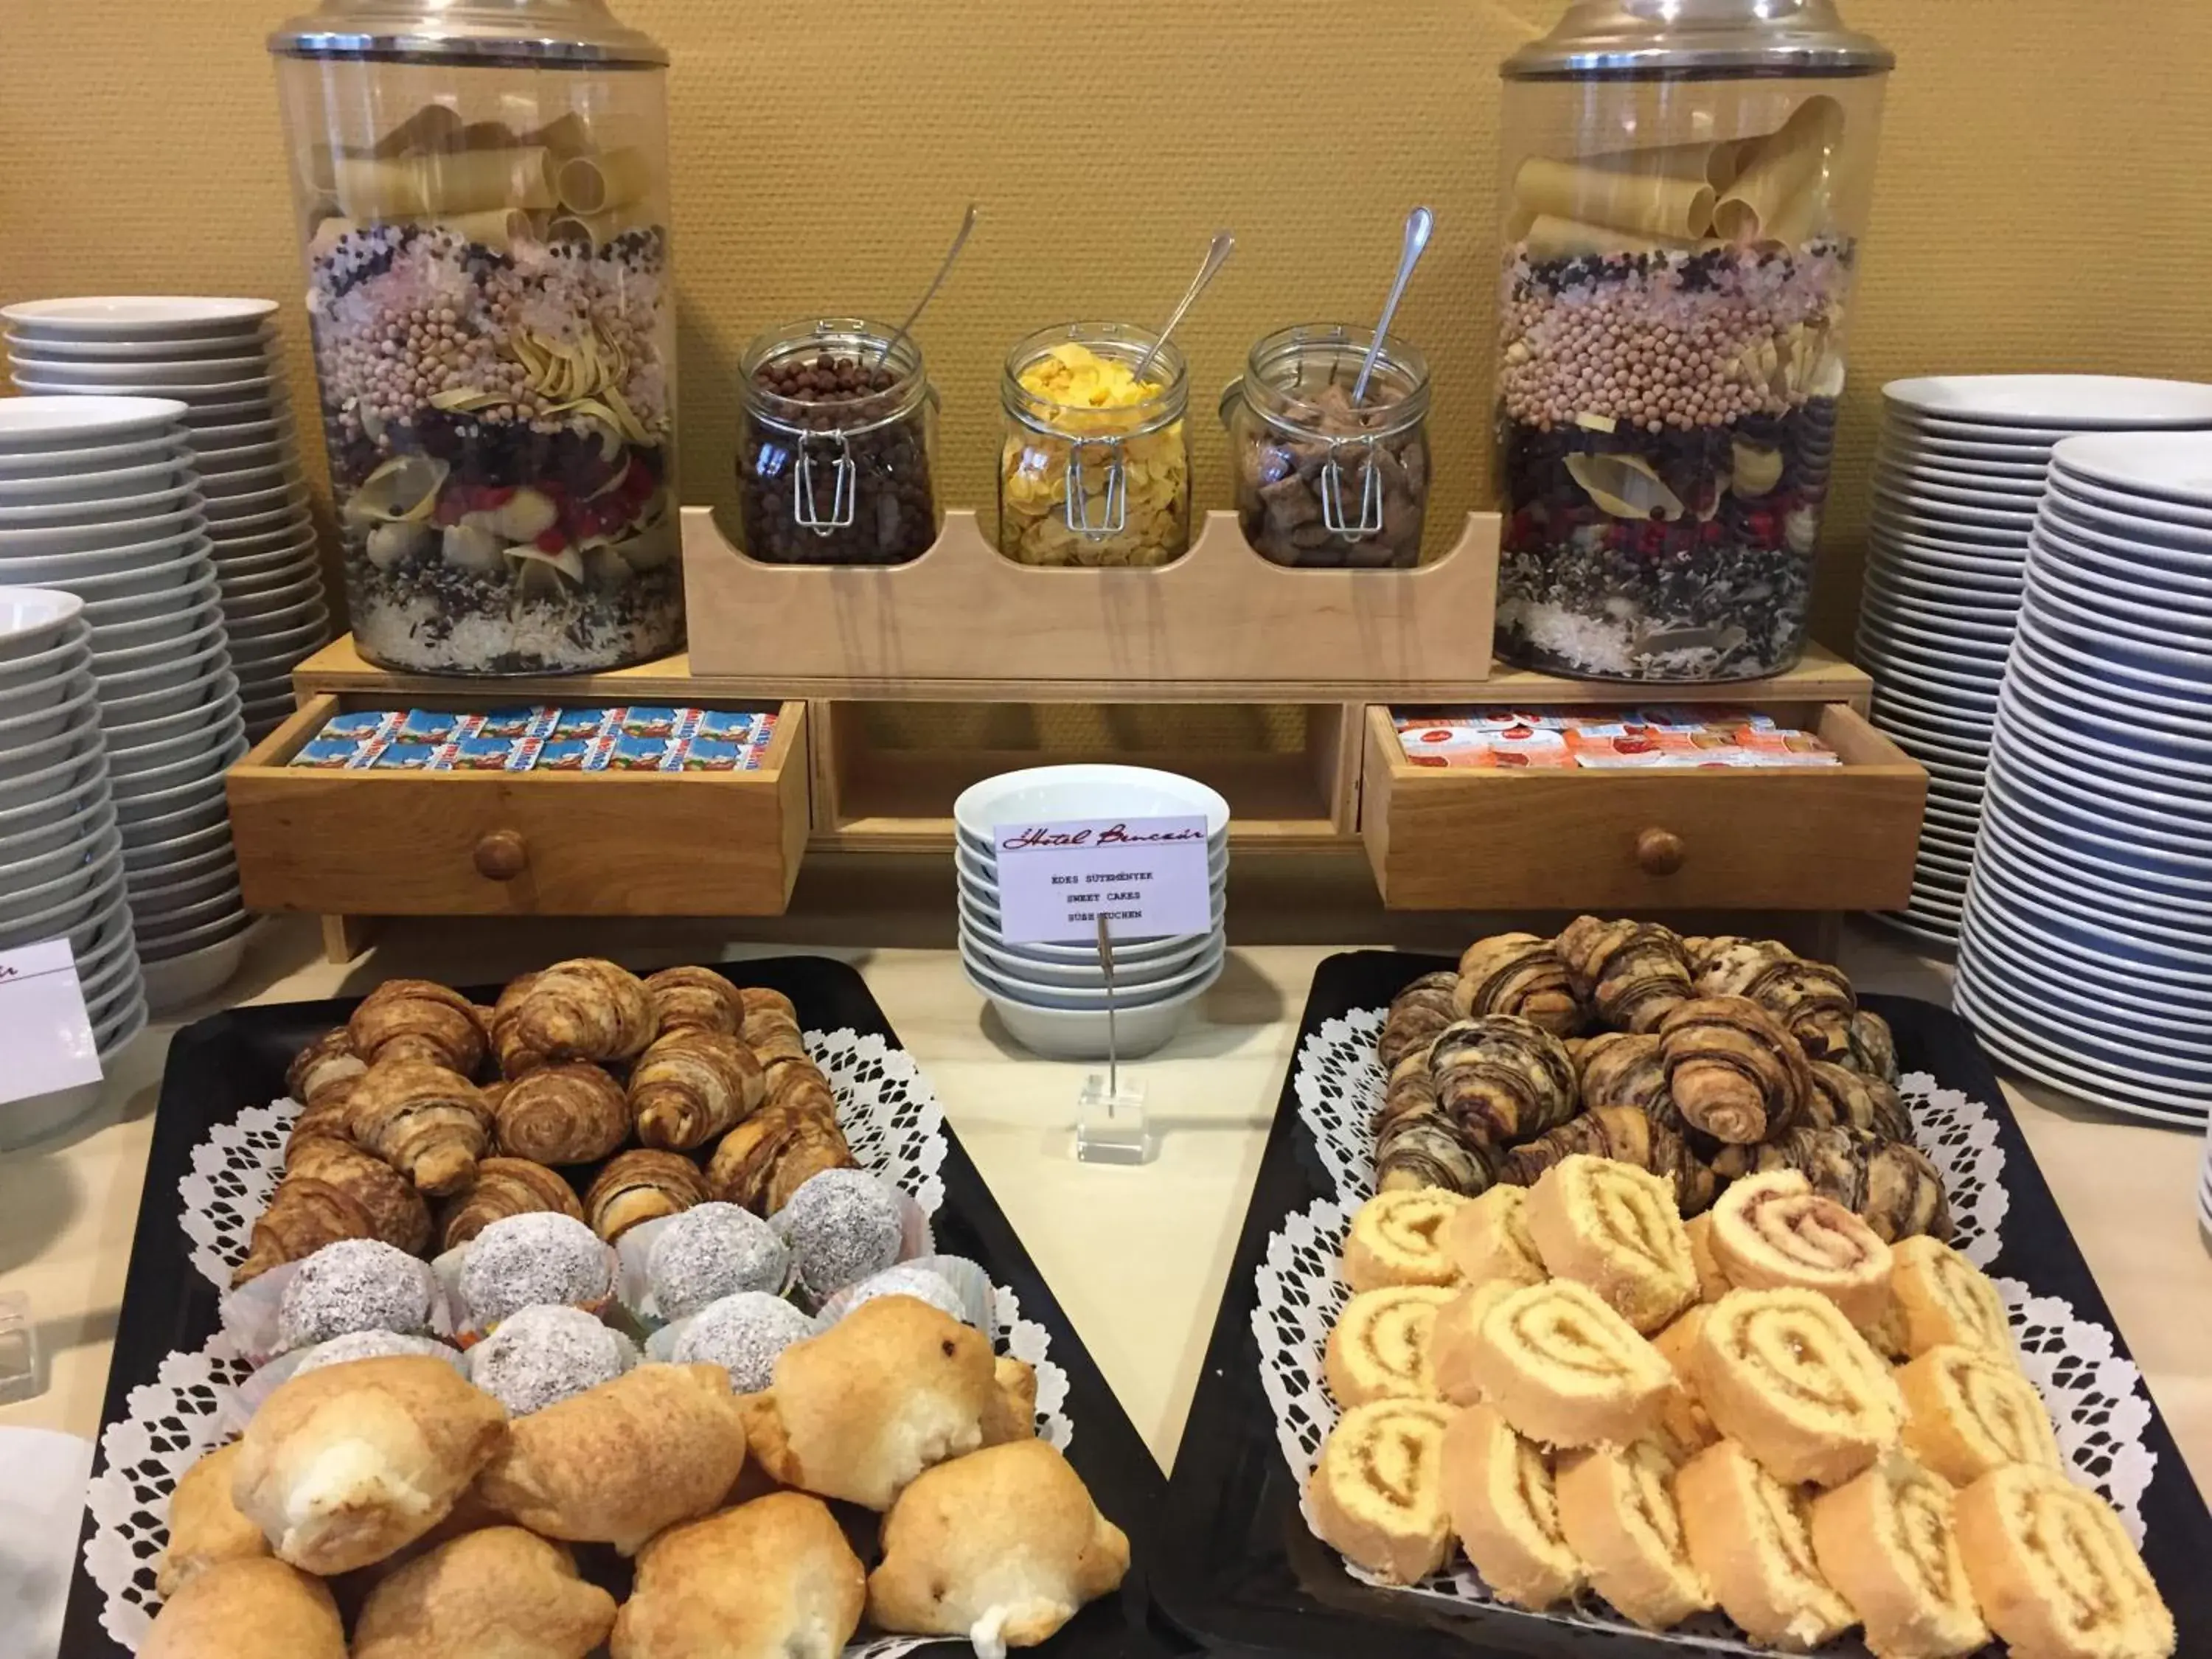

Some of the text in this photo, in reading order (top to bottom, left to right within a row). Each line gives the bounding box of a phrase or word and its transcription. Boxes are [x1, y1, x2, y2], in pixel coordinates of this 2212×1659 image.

[1003, 828, 1092, 849] Hotel
[1067, 891, 1141, 903] SWEET CAKES
